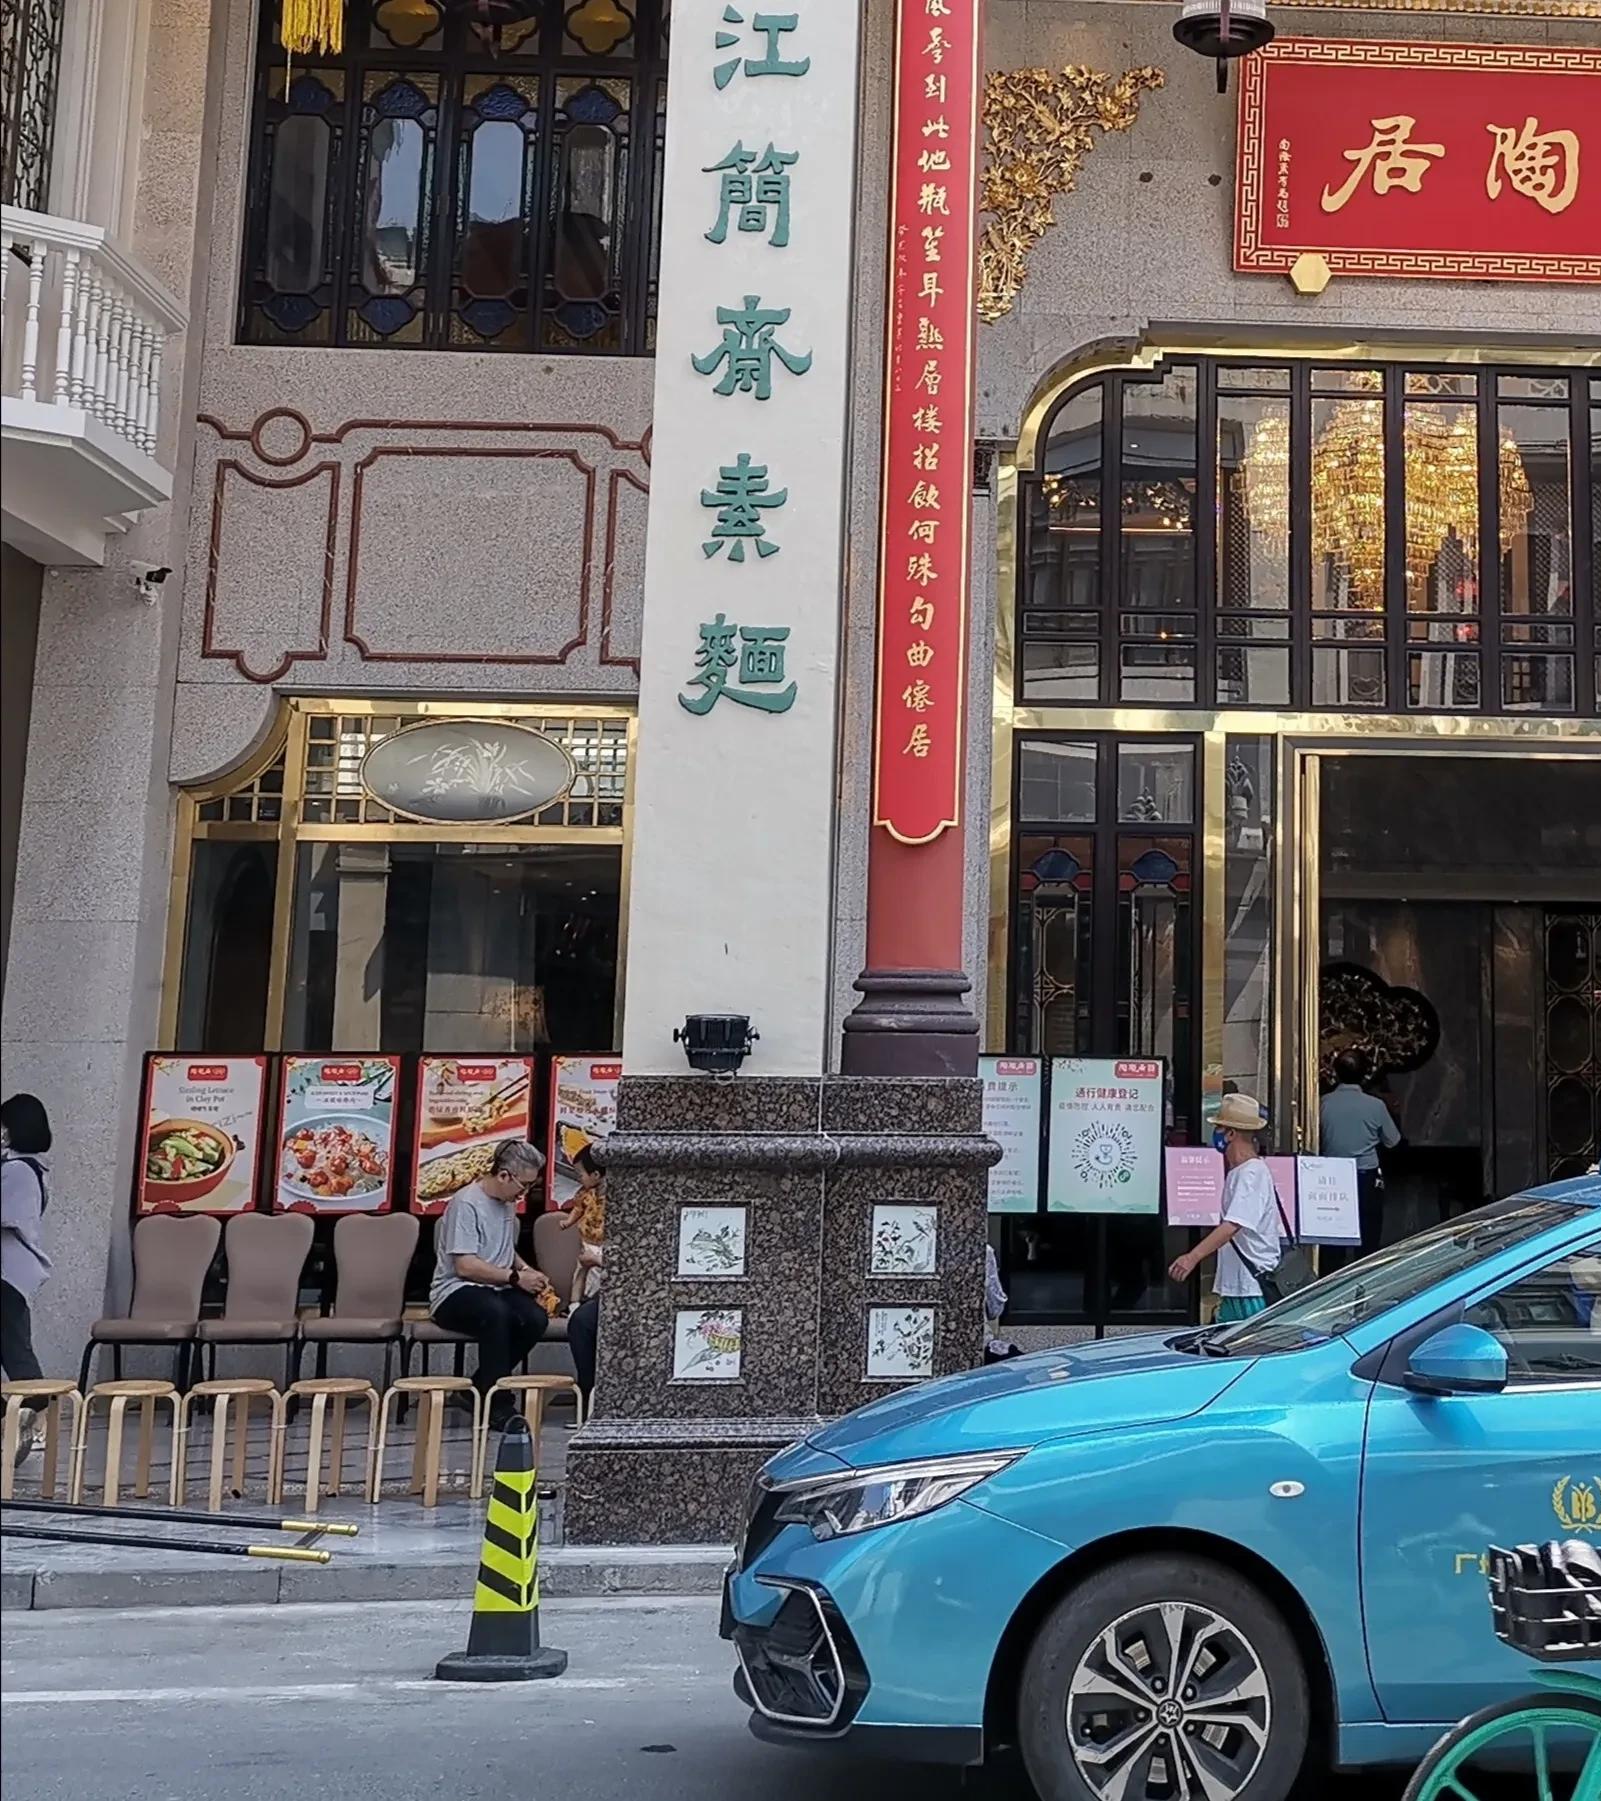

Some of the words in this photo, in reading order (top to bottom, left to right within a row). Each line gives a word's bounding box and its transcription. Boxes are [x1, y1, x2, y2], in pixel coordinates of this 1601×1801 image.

[1075, 1087, 1139, 1100] 通行健康登记
